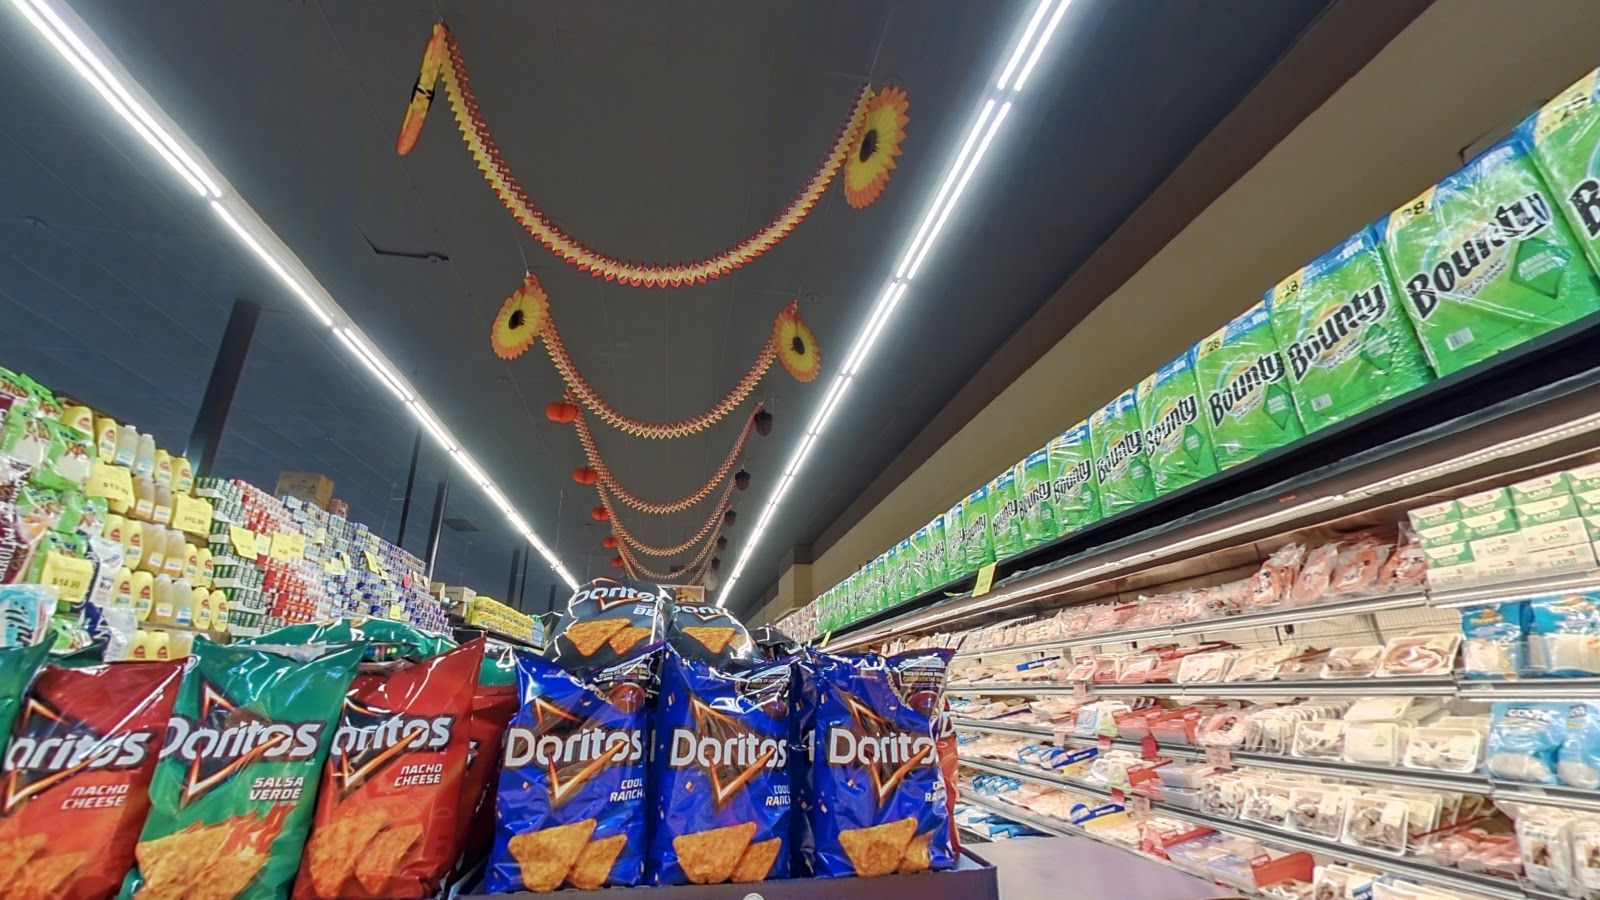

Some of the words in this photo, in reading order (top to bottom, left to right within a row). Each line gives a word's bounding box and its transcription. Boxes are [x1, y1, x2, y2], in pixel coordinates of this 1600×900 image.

[1406, 193, 1549, 319] Bounty
[1287, 284, 1387, 381] Bounty
[1208, 352, 1285, 427] Bounty
[1096, 431, 1143, 484] Bounty
[1053, 459, 1091, 504] Bounty
[1018, 481, 1050, 521] Bounty
[632, 606, 657, 617] BB
[672, 605, 721, 614] Dori
[5, 732, 152, 771] oritos
[159, 717, 322, 760] Doritos
[331, 716, 454, 755] oritos
[505, 728, 643, 766] Doritos
[670, 728, 788, 768] Doritos
[829, 727, 938, 765] Dorito
[252, 777, 303, 789] SALSA
[394, 774, 442, 787] CHEESE
[400, 763, 443, 776] NACHO
[620, 778, 643, 790] COOL
[61, 796, 126, 810] CHEESE
[71, 784, 130, 797] NACHO
[249, 788, 302, 801] VERDE
[609, 790, 643, 802] RANCH
